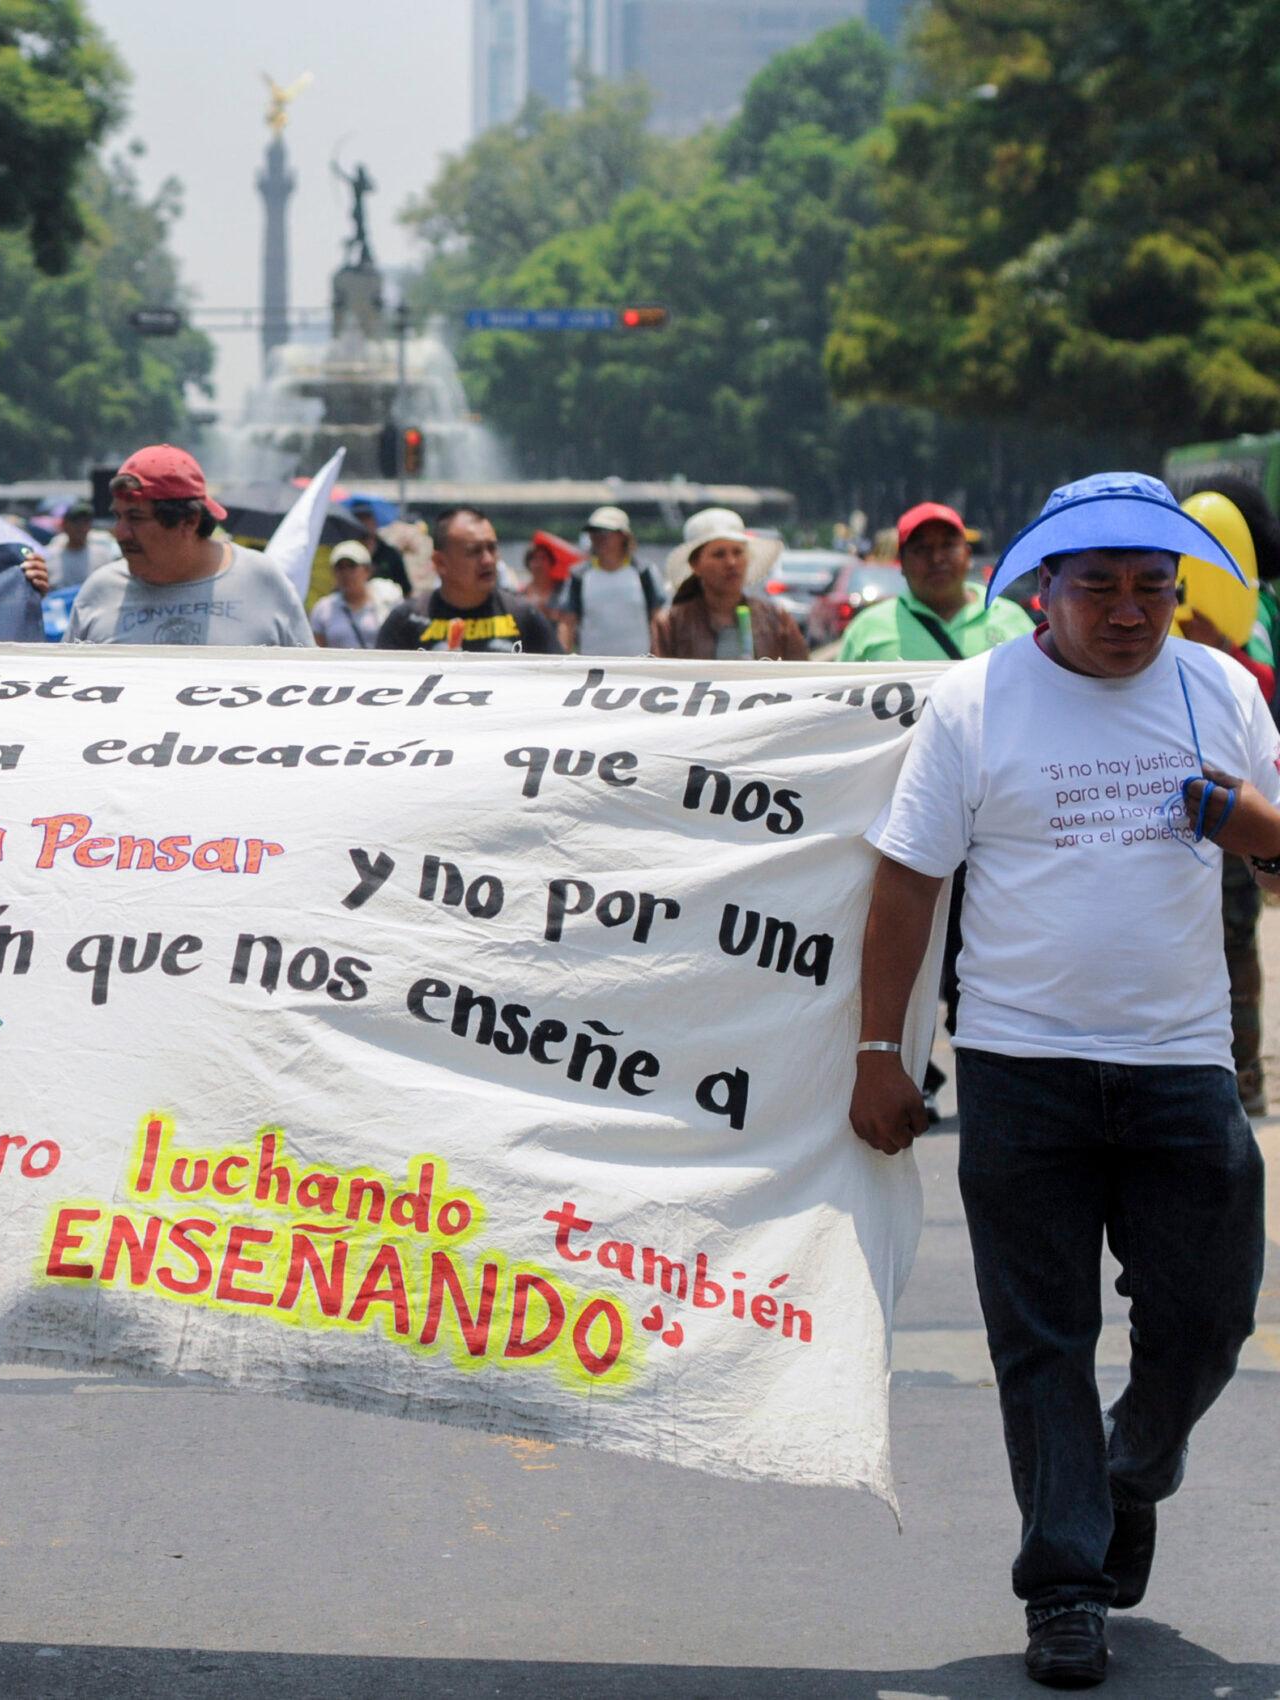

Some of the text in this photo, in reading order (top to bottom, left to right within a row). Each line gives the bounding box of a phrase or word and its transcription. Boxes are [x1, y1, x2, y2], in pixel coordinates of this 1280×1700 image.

[122, 600, 244, 632] CONVERSE
[176, 674, 492, 708] escuela
[1069, 762, 1093, 778] no
[1097, 757, 1132, 776] hay
[1135, 752, 1195, 774] justicia
[83, 732, 453, 768] educación
[504, 747, 638, 798] que
[682, 765, 804, 835] nos
[1056, 784, 1099, 808] para
[1105, 781, 1121, 799] el
[1049, 814, 1086, 831] que
[1091, 806, 1116, 822] no
[1055, 832, 1094, 850] para
[1100, 828, 1116, 843] el
[31, 813, 284, 873] Pensar
[341, 848, 395, 910] y
[419, 855, 504, 919] no
[544, 878, 681, 944] por
[719, 902, 834, 986] una
[67, 933, 203, 1005] que
[229, 933, 373, 1001] nos
[407, 977, 660, 1097] enseñe
[695, 1066, 750, 1130] a
[135, 1119, 472, 1237] luchando
[543, 1201, 813, 1343] también
